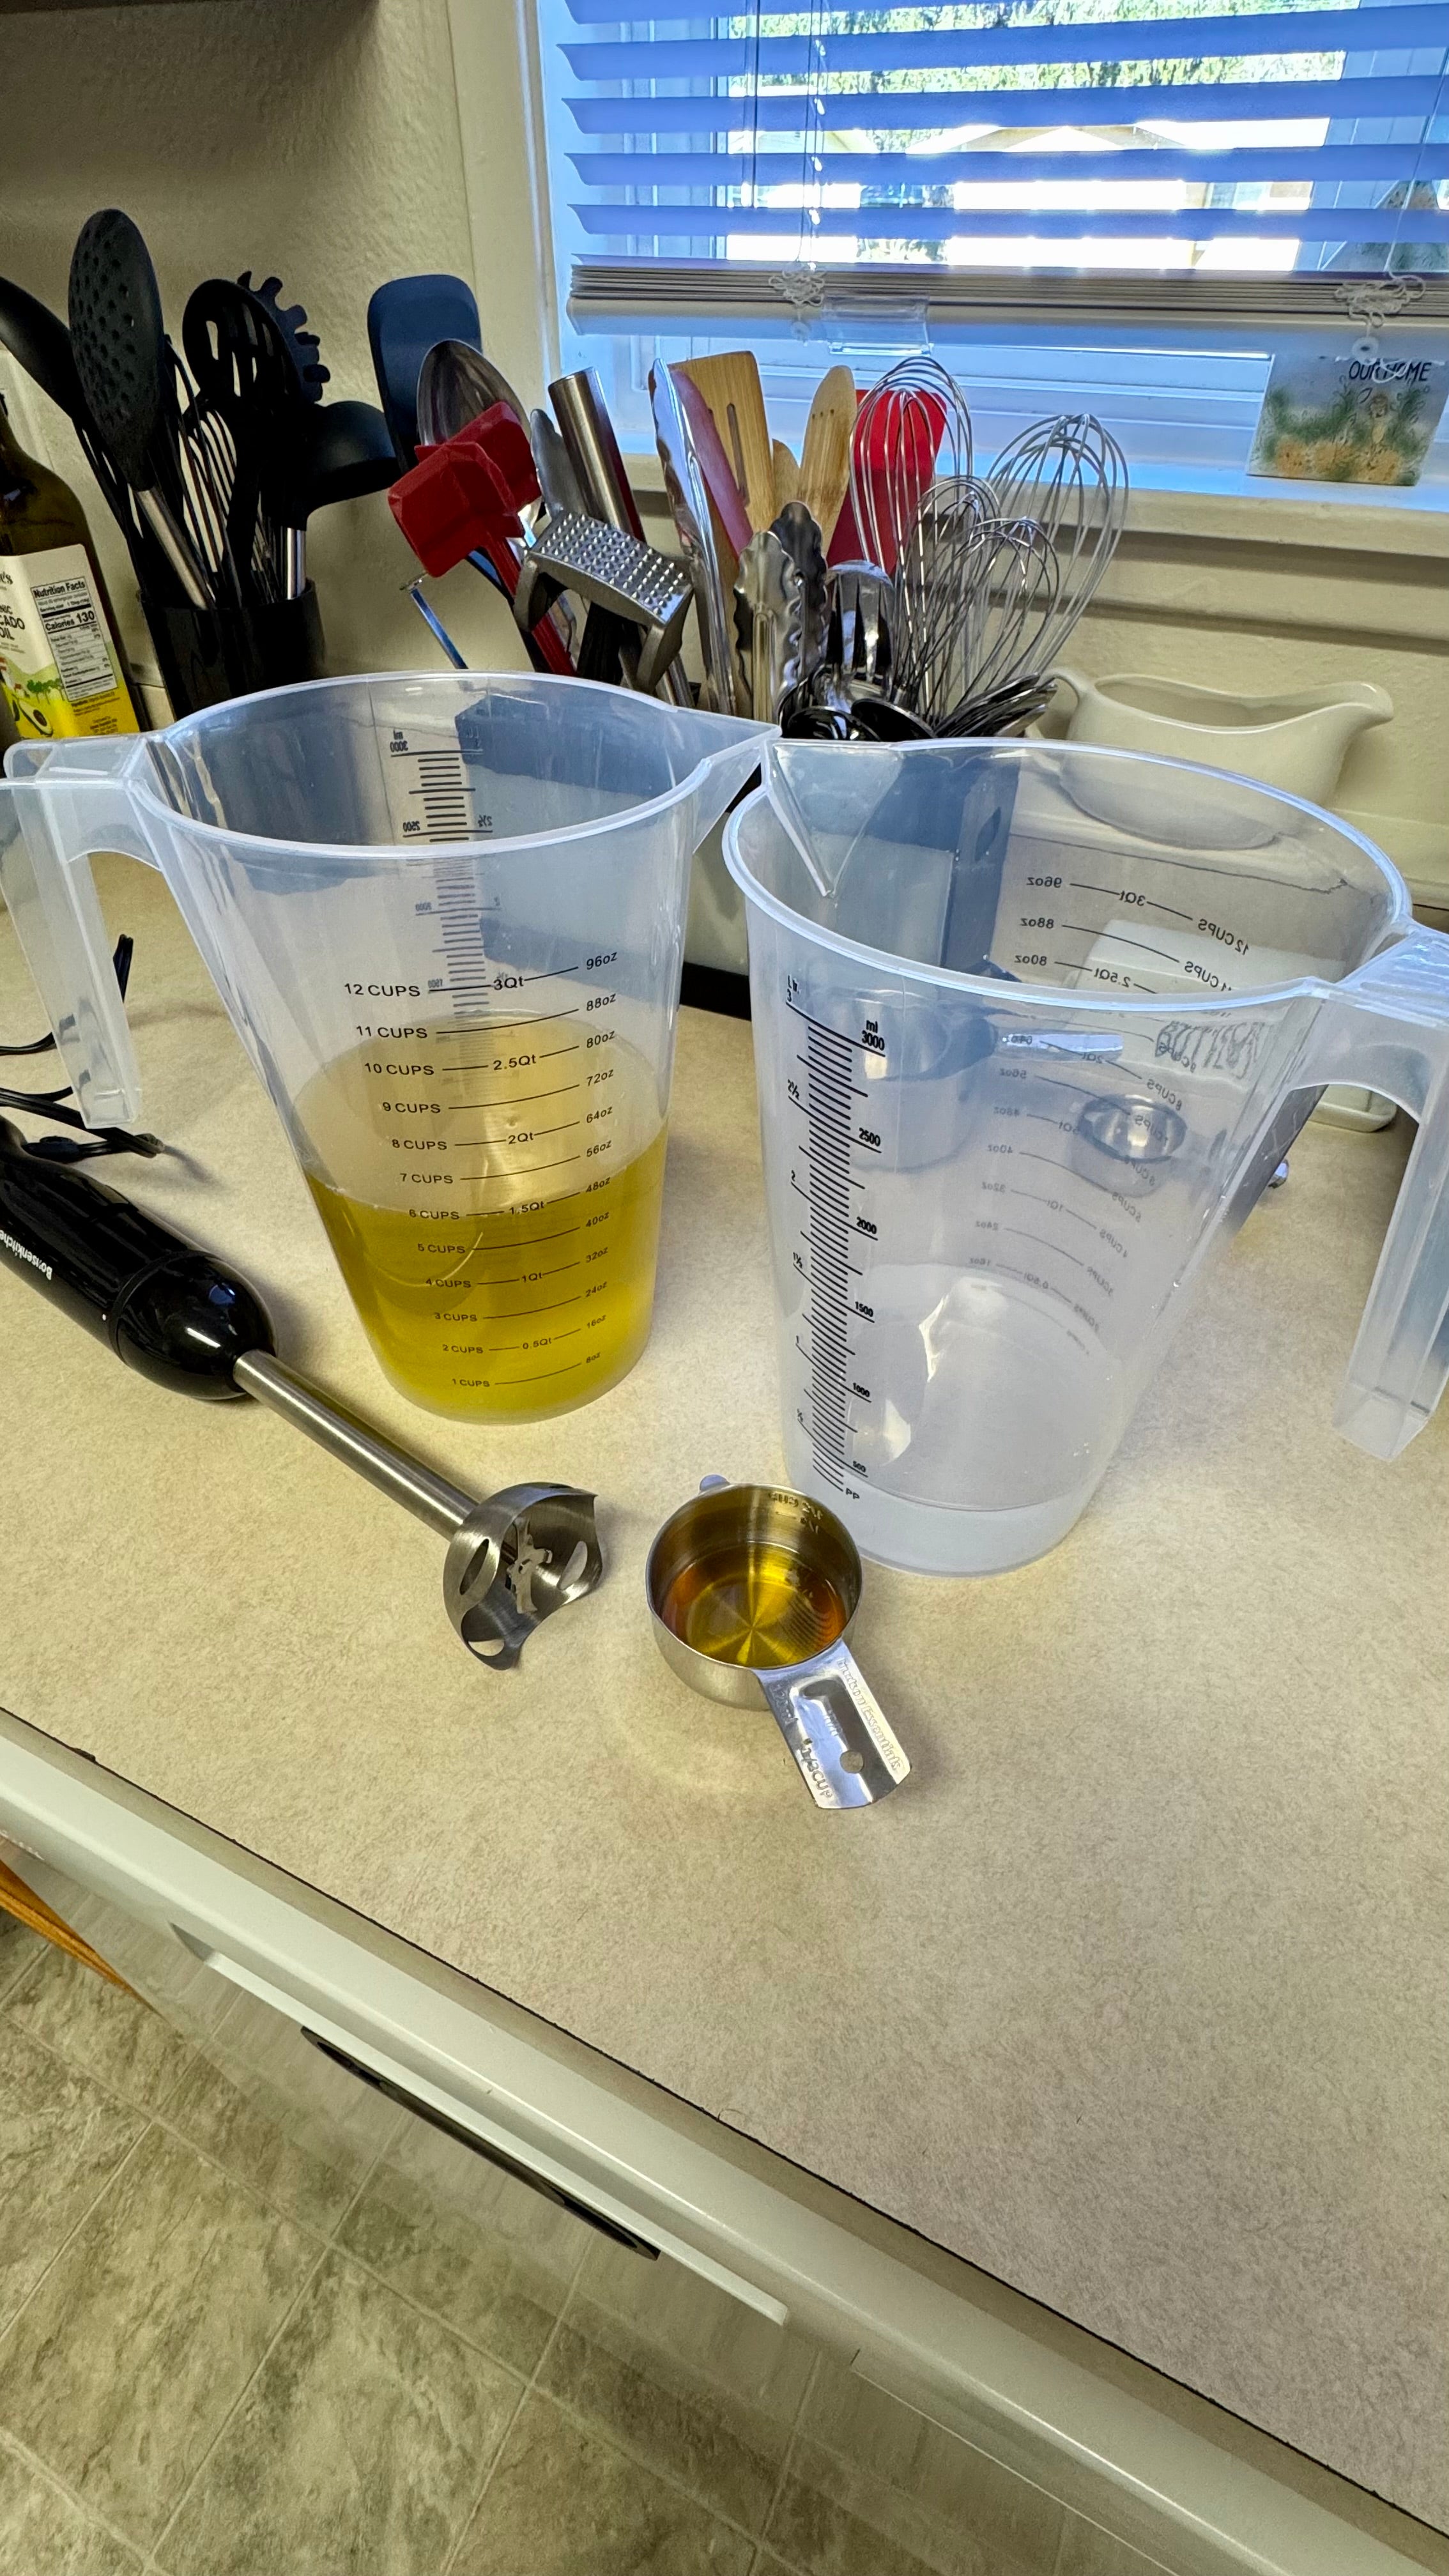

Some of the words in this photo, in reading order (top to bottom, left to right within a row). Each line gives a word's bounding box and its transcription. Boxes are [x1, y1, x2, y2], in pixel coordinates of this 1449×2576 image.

[33, 586, 65, 598] Nutrition
[66, 580, 86, 591] Facts
[45, 619, 75, 631] Calories
[76, 610, 95, 624] 130
[344, 983, 364, 995] 12
[367, 985, 421, 997] CUPS
[493, 976, 524, 991] 3Qt
[586, 951, 617, 970] 96oz
[356, 1025, 372, 1037] 11
[377, 1027, 428, 1039] CUPS
[586, 993, 617, 1011] 88oz
[866, 1020, 878, 1034] ml
[364, 1062, 382, 1074] 10
[386, 1064, 434, 1076] CUPS
[493, 1054, 537, 1071] 2.5Qt
[586, 1031, 615, 1048] 80oz
[861, 1030, 885, 1051] 3000
[382, 1101, 391, 1112] 9
[395, 1103, 441, 1114] CUPS
[586, 1069, 614, 1087] 72oz
[392, 1139, 401, 1149] 8
[403, 1140, 448, 1151] CUPS
[508, 1132, 534, 1145] 2Qt
[586, 1106, 613, 1124] 64oz
[859, 1127, 881, 1147] 2500
[400, 1173, 408, 1183] 7
[411, 1174, 454, 1184] CUPS
[586, 1140, 612, 1158] 56oz
[409, 1209, 417, 1218] 6
[420, 1210, 460, 1220] CUPS
[509, 1201, 545, 1215] 1.5Qt
[585, 1177, 611, 1193] 48oz
[791, 1169, 796, 1182] 2
[856, 1216, 878, 1235] 2000
[417, 1243, 425, 1252] 5
[427, 1245, 466, 1254] CUPS
[585, 1211, 610, 1228] 40oz
[435, 1278, 471, 1289] CUPS
[521, 1272, 542, 1283] 1Qt
[586, 1246, 609, 1263] 32oz
[443, 1312, 478, 1322] CUPS
[585, 1281, 608, 1298] 24oz
[855, 1301, 874, 1318] 1500
[443, 1344, 449, 1352] 2
[451, 1345, 484, 1354] CUPS
[522, 1338, 552, 1350] 0.5Qt
[586, 1314, 607, 1329] 16oz
[459, 1379, 490, 1388] CUPS
[585, 1351, 601, 1364] 8oz
[852, 1382, 870, 1398] 1000
[852, 1460, 866, 1473] 500
[845, 1487, 860, 1500] PP
